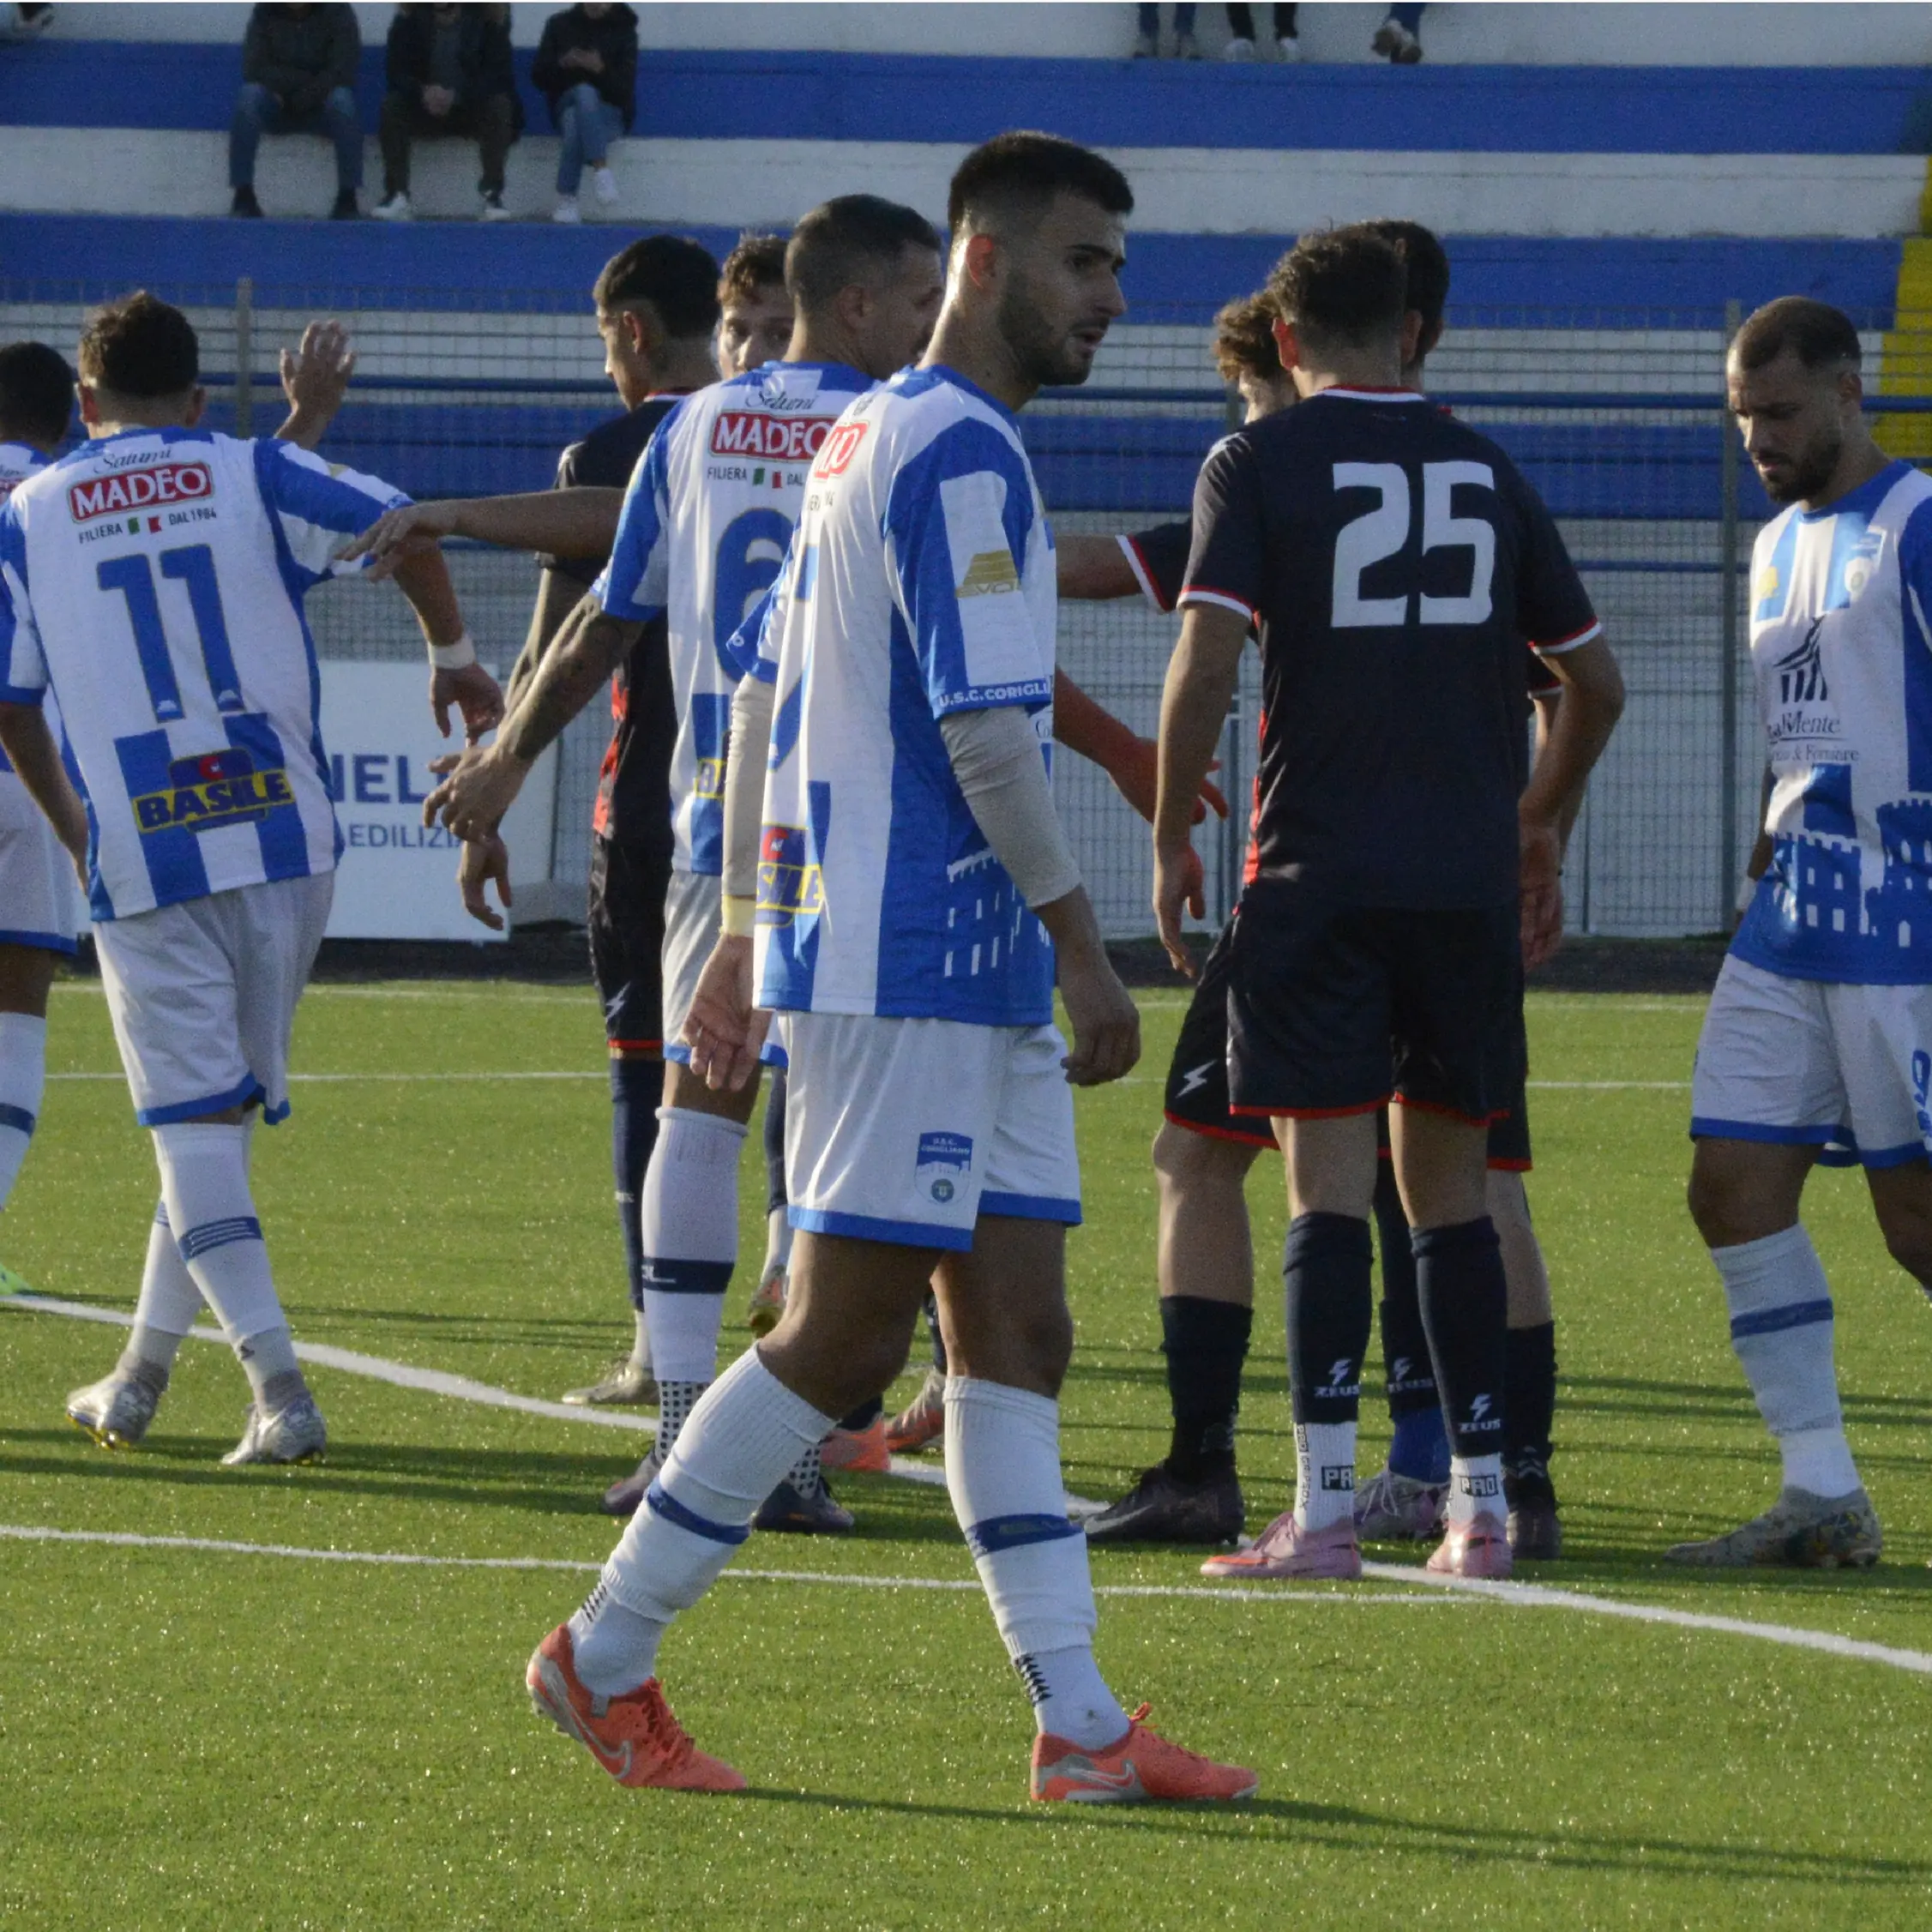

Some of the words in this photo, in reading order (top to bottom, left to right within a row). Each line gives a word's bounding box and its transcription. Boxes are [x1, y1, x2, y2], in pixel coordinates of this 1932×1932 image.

[74, 467, 208, 518] MADEO
[707, 466, 748, 481] FILIERA
[78, 522, 123, 545] FILIERA
[1331, 460, 1496, 628] 25
[96, 543, 246, 724] 11
[135, 772, 292, 821] BASILE
[331, 754, 449, 804] EL
[1314, 1386, 1359, 1398] ZEUS
[1460, 1418, 1501, 1434] ZEUS
